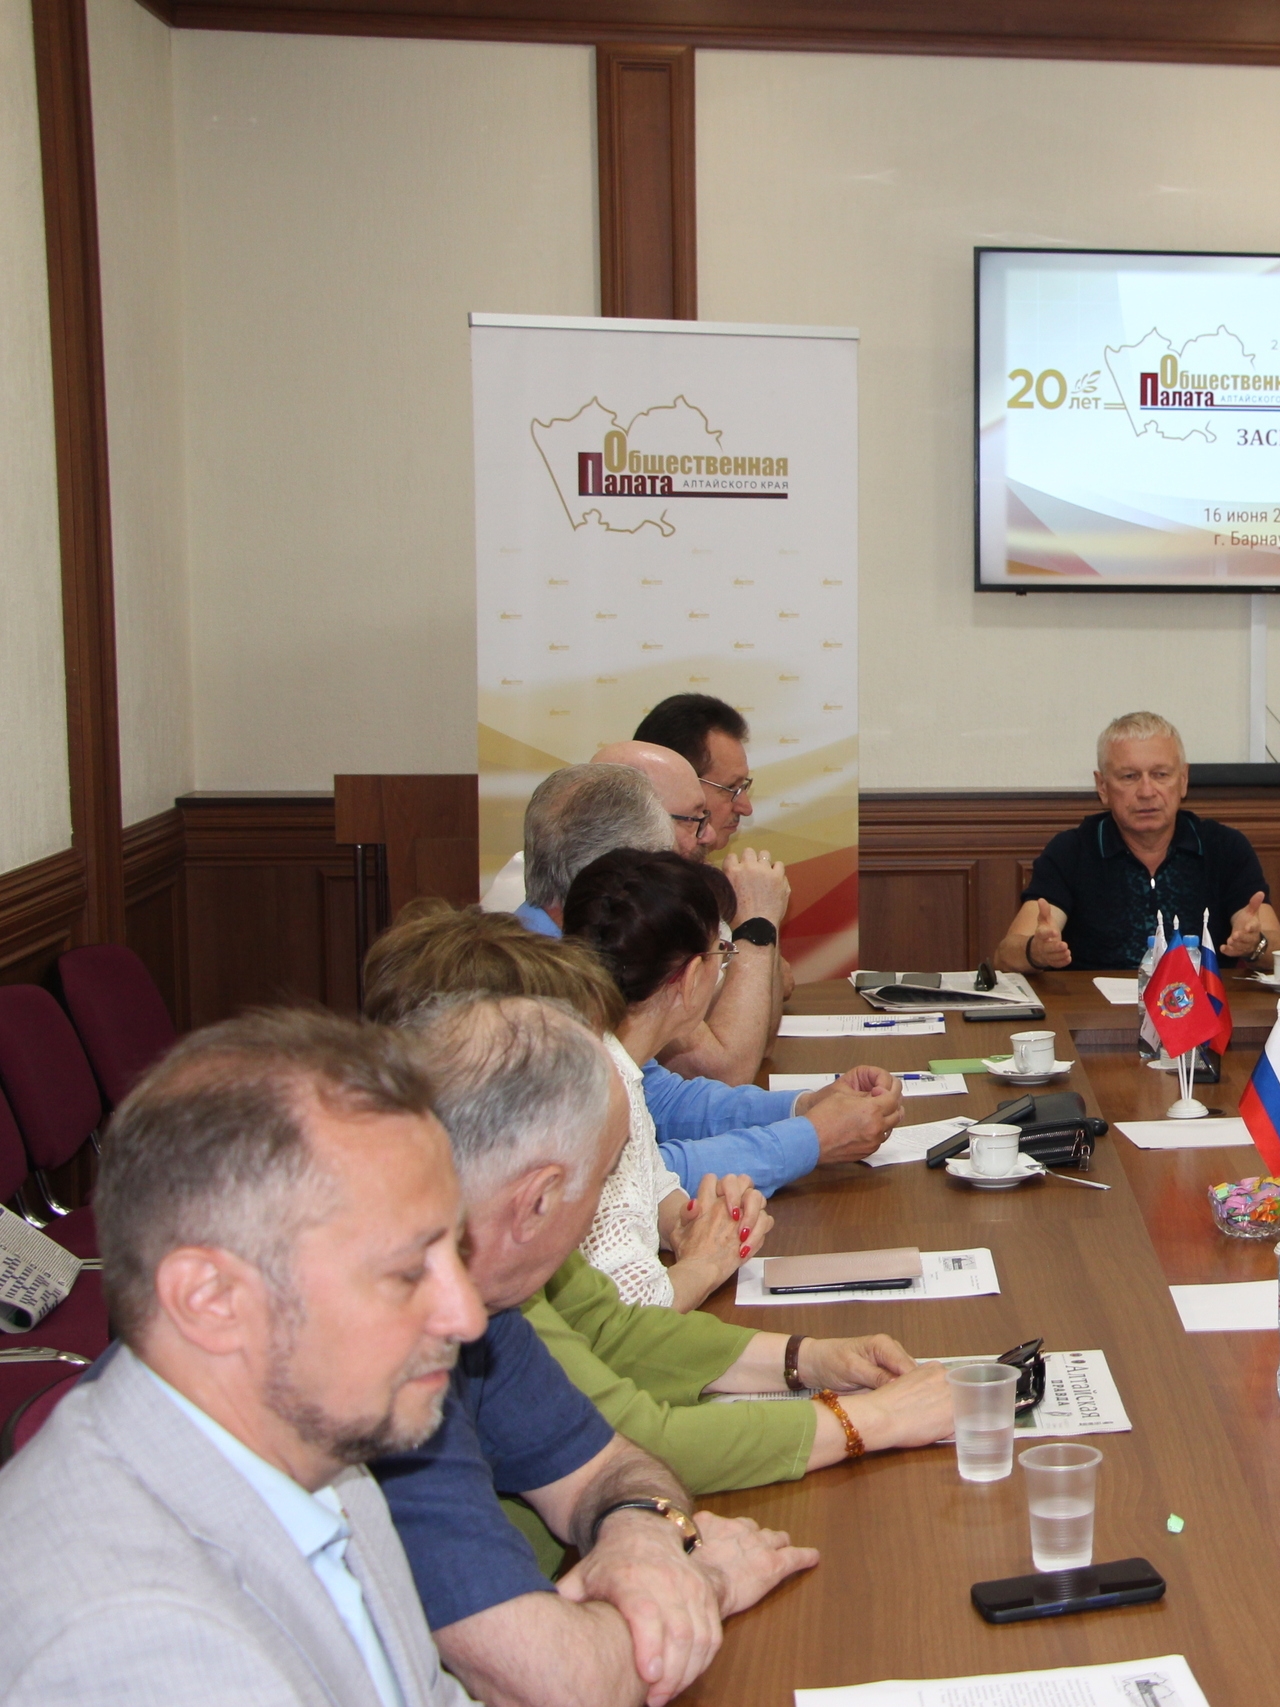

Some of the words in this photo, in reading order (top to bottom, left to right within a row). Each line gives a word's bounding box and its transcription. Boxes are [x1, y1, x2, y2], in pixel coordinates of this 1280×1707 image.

[1007, 368, 1068, 410] 20
[1068, 396, 1101, 410] лет
[1140, 372, 1215, 407] Палата
[604, 430, 788, 476] Общественная
[578, 452, 674, 495] Палата
[683, 478, 758, 489] АЛТАЙСКОГО
[760, 481, 790, 490] КРАЯ
[1204, 508, 1221, 522] 16
[1227, 511, 1268, 522] июня
[1214, 534, 1225, 546] г.
[1051, 1380, 1071, 1407] ПРАВДА
[1065, 1365, 1100, 1418] Алтайская
